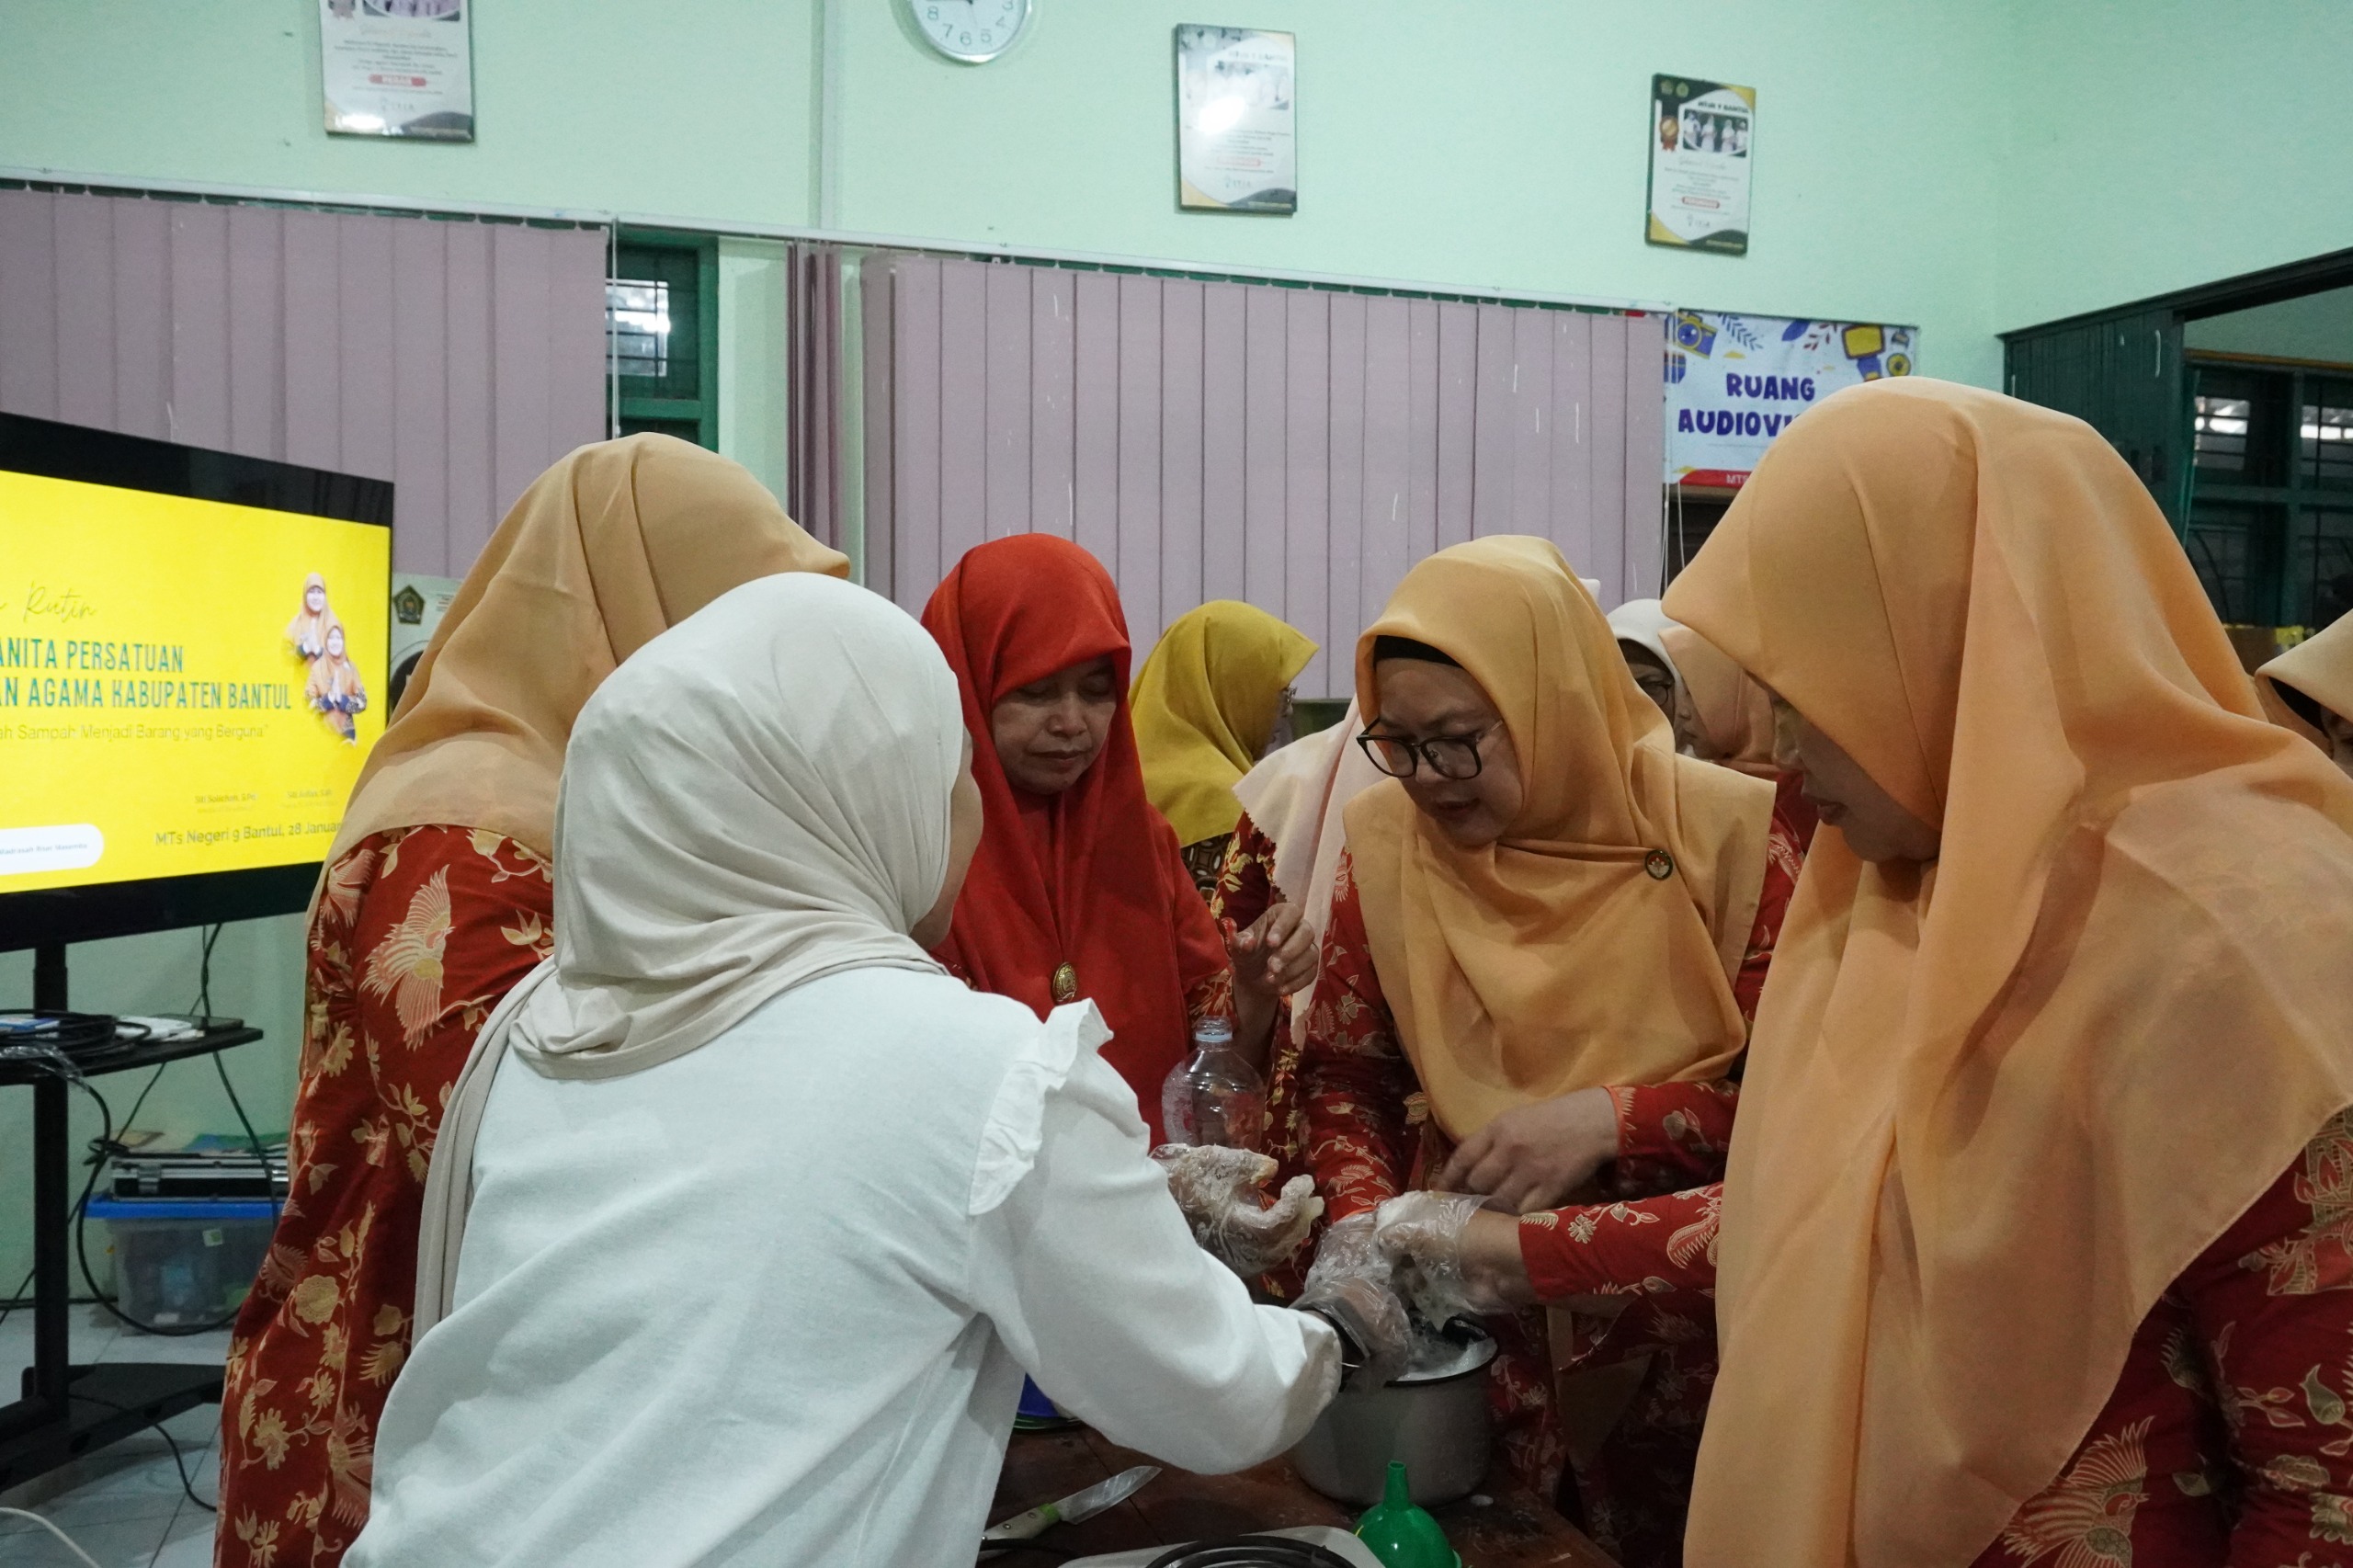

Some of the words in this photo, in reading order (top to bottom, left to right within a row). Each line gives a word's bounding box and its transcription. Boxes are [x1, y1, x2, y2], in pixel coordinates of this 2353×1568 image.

[927, 6, 938, 20] 8
[943, 23, 953, 38] 7
[960, 31, 972, 45] 6
[981, 28, 992, 42] 5
[1725, 372, 1815, 402] RUANG
[1677, 408, 1800, 437] AUDIOV
[23, 580, 96, 624] Rutin
[66, 640, 184, 674] PERSATUAN
[0, 676, 18, 708] N
[28, 677, 104, 708] AGAMA
[111, 679, 222, 710] KABUPATEN
[228, 682, 291, 710] BANTUL
[17, 723, 76, 743] Sampah
[81, 724, 132, 743] Menjadi
[136, 724, 180, 742] Barang
[184, 726, 212, 741] yang
[155, 831, 183, 846] MTs
[187, 828, 229, 846] Negeri
[233, 829, 240, 842] 9
[243, 825, 285, 840] Bantul,
[288, 823, 301, 835] 28
